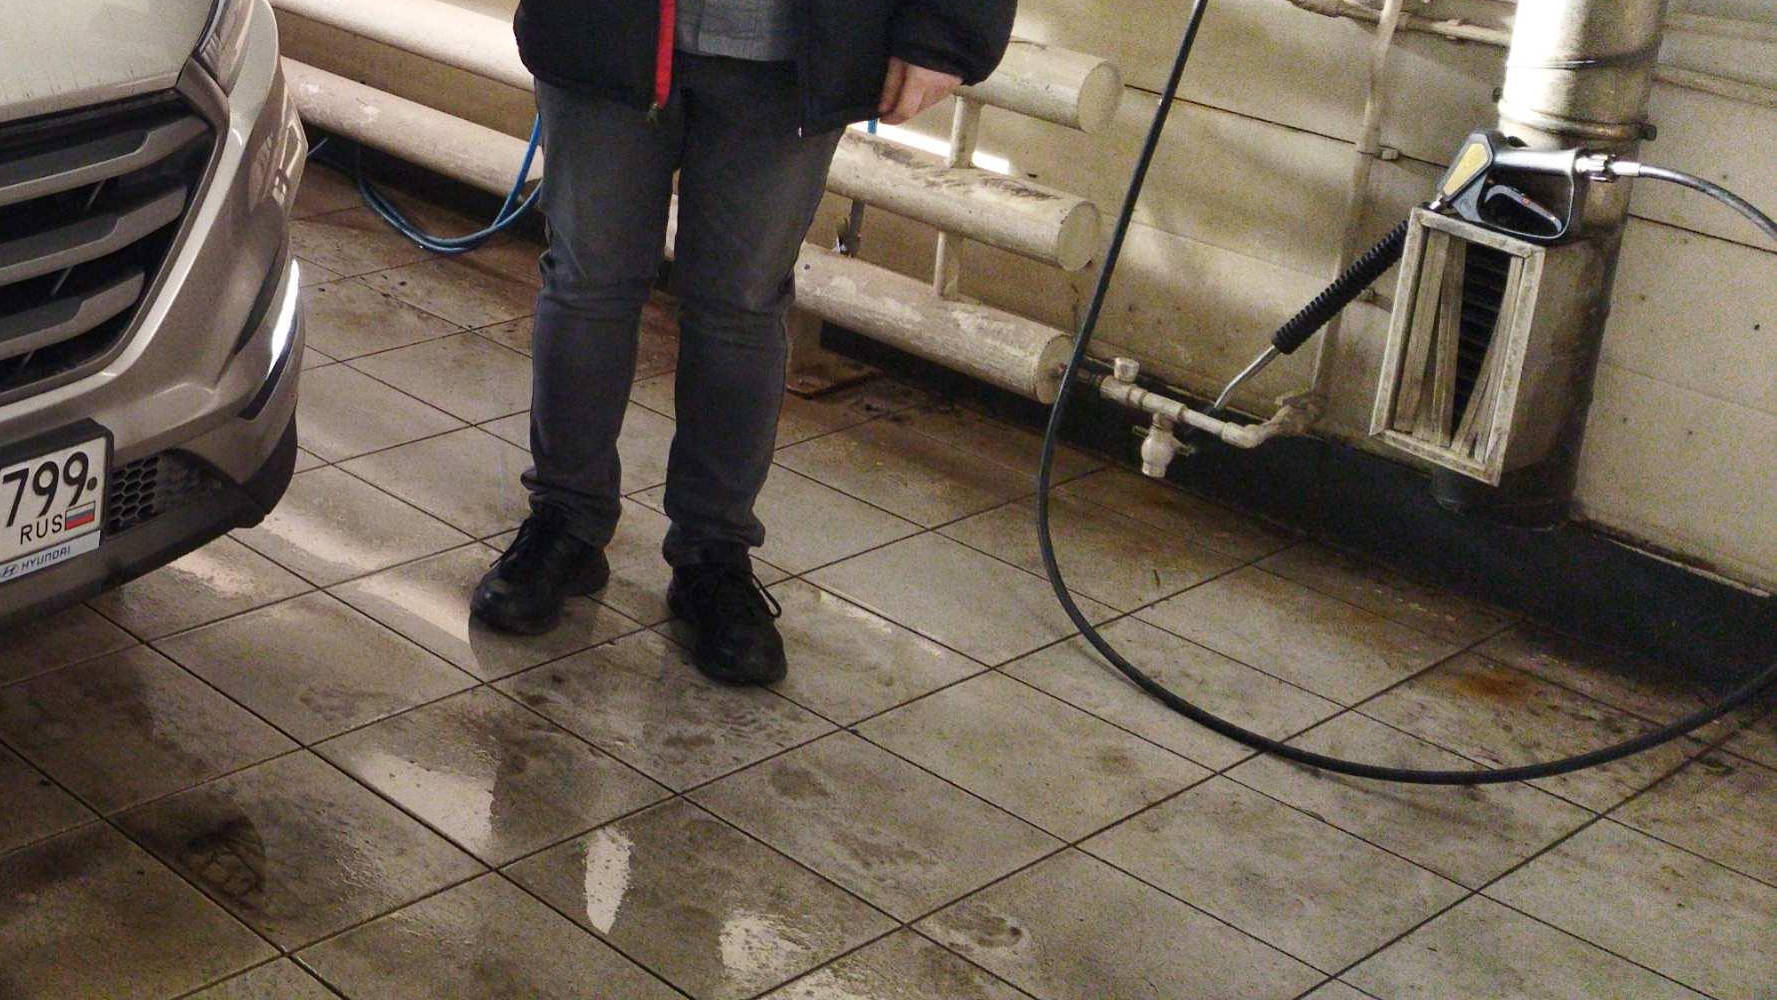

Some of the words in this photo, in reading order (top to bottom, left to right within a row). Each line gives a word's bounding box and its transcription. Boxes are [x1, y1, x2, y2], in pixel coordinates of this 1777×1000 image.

[2, 451, 89, 528] 799
[20, 513, 64, 545] RUS
[21, 546, 71, 570] HYUNDAI
